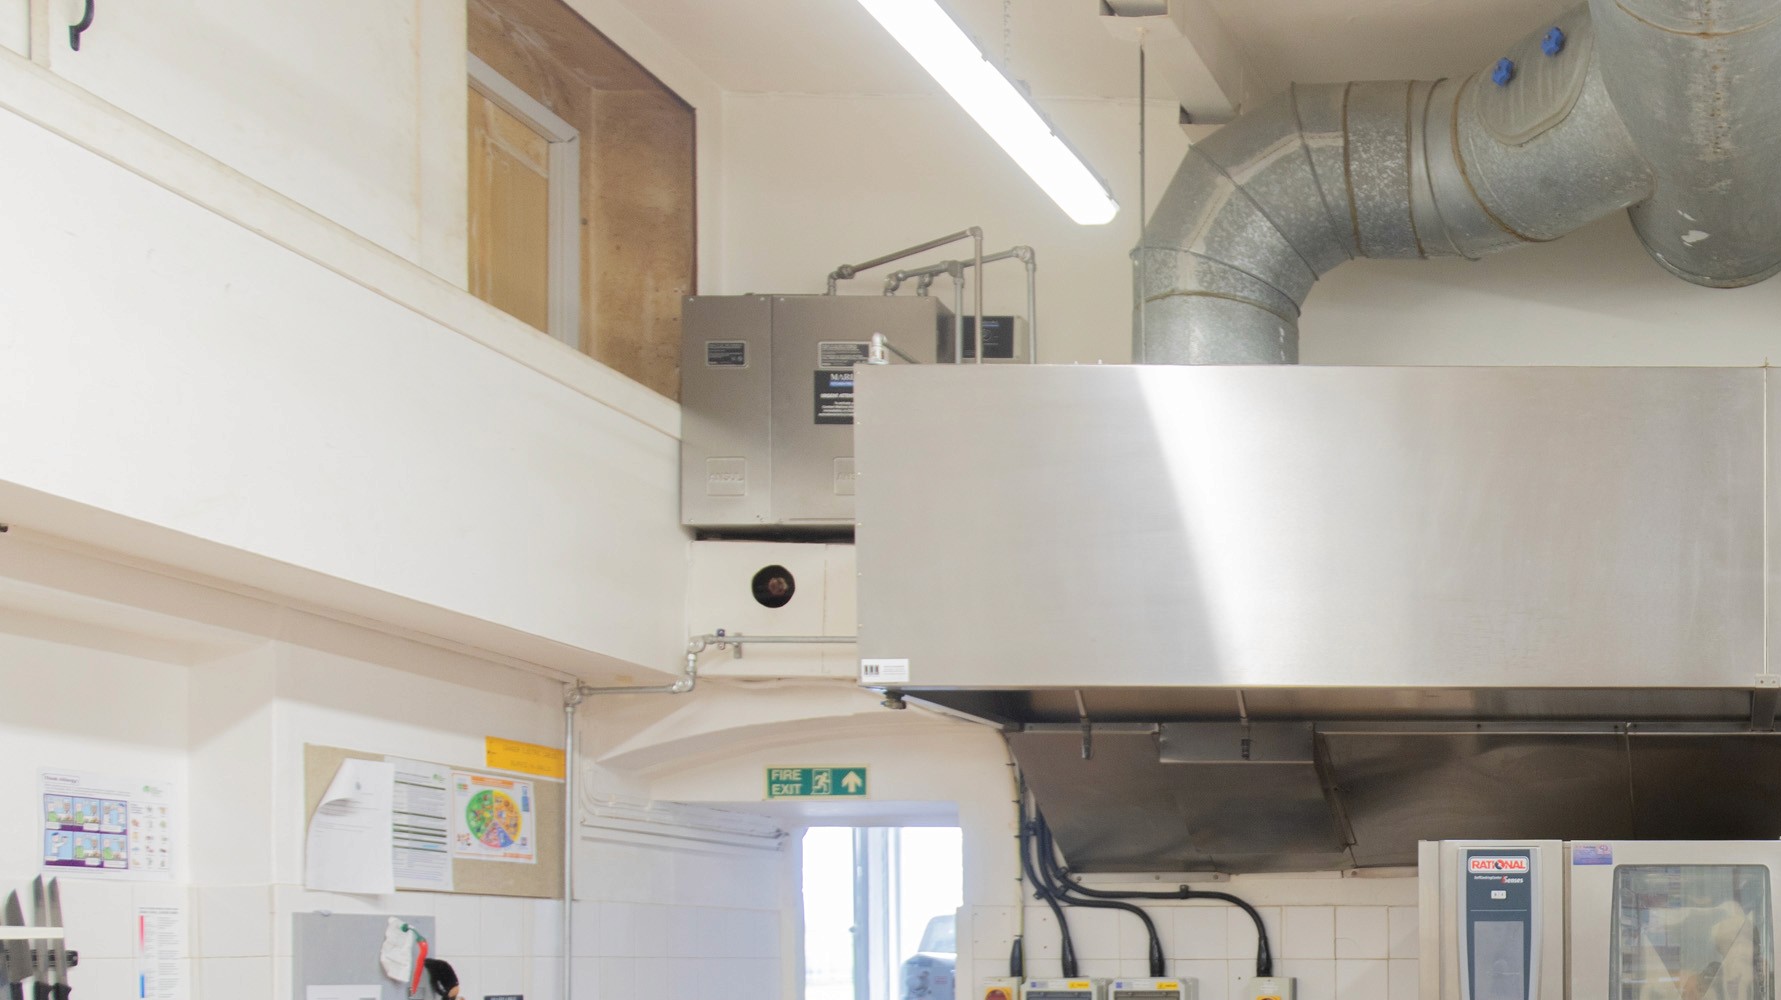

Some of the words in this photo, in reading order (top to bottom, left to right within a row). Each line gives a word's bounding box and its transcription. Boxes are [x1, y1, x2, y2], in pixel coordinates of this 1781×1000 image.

[772, 769, 802, 781] FIRE
[772, 784, 802, 795] EXIT
[1471, 859, 1526, 870] RATIONAL
